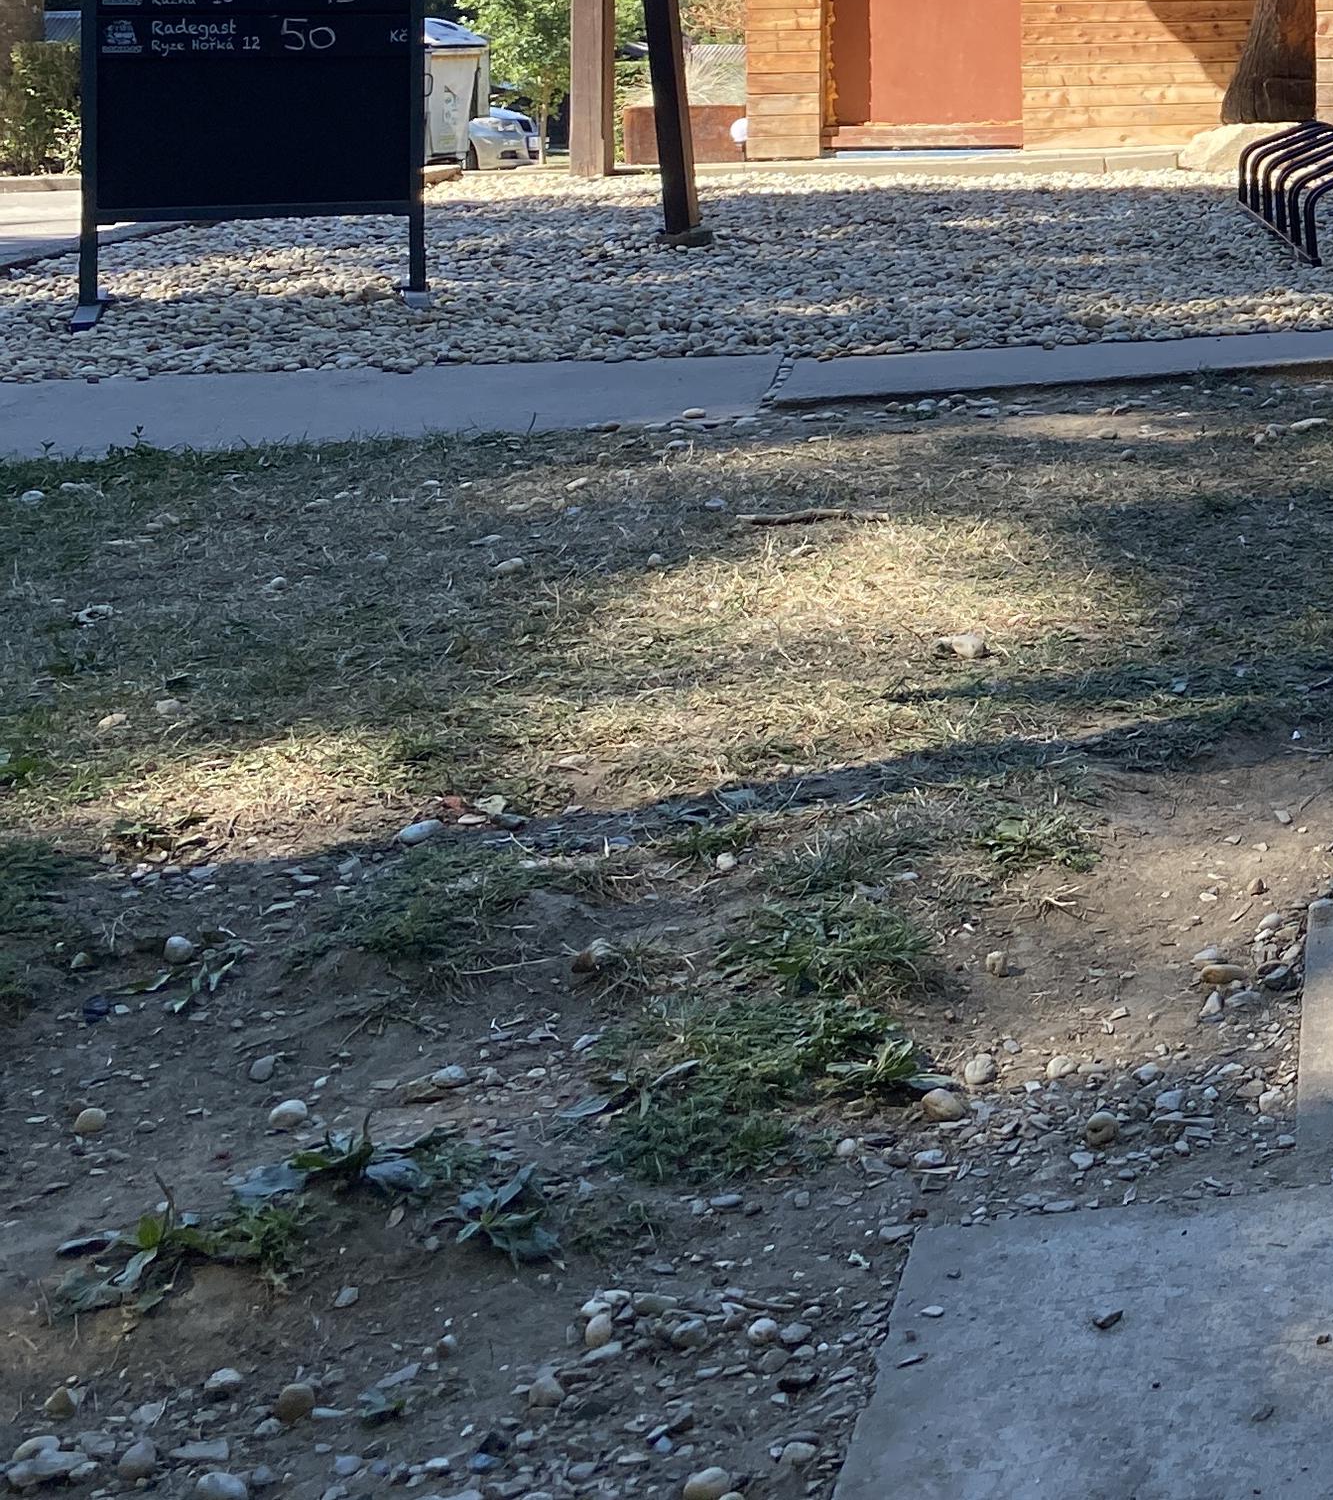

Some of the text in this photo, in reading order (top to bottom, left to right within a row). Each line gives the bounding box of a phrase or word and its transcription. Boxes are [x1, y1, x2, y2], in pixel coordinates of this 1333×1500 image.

[151, 18, 237, 40] Radegast
[281, 18, 409, 50] 50 Kč
[191, 36, 235, 50] Hořká
[242, 36, 261, 50] 12
